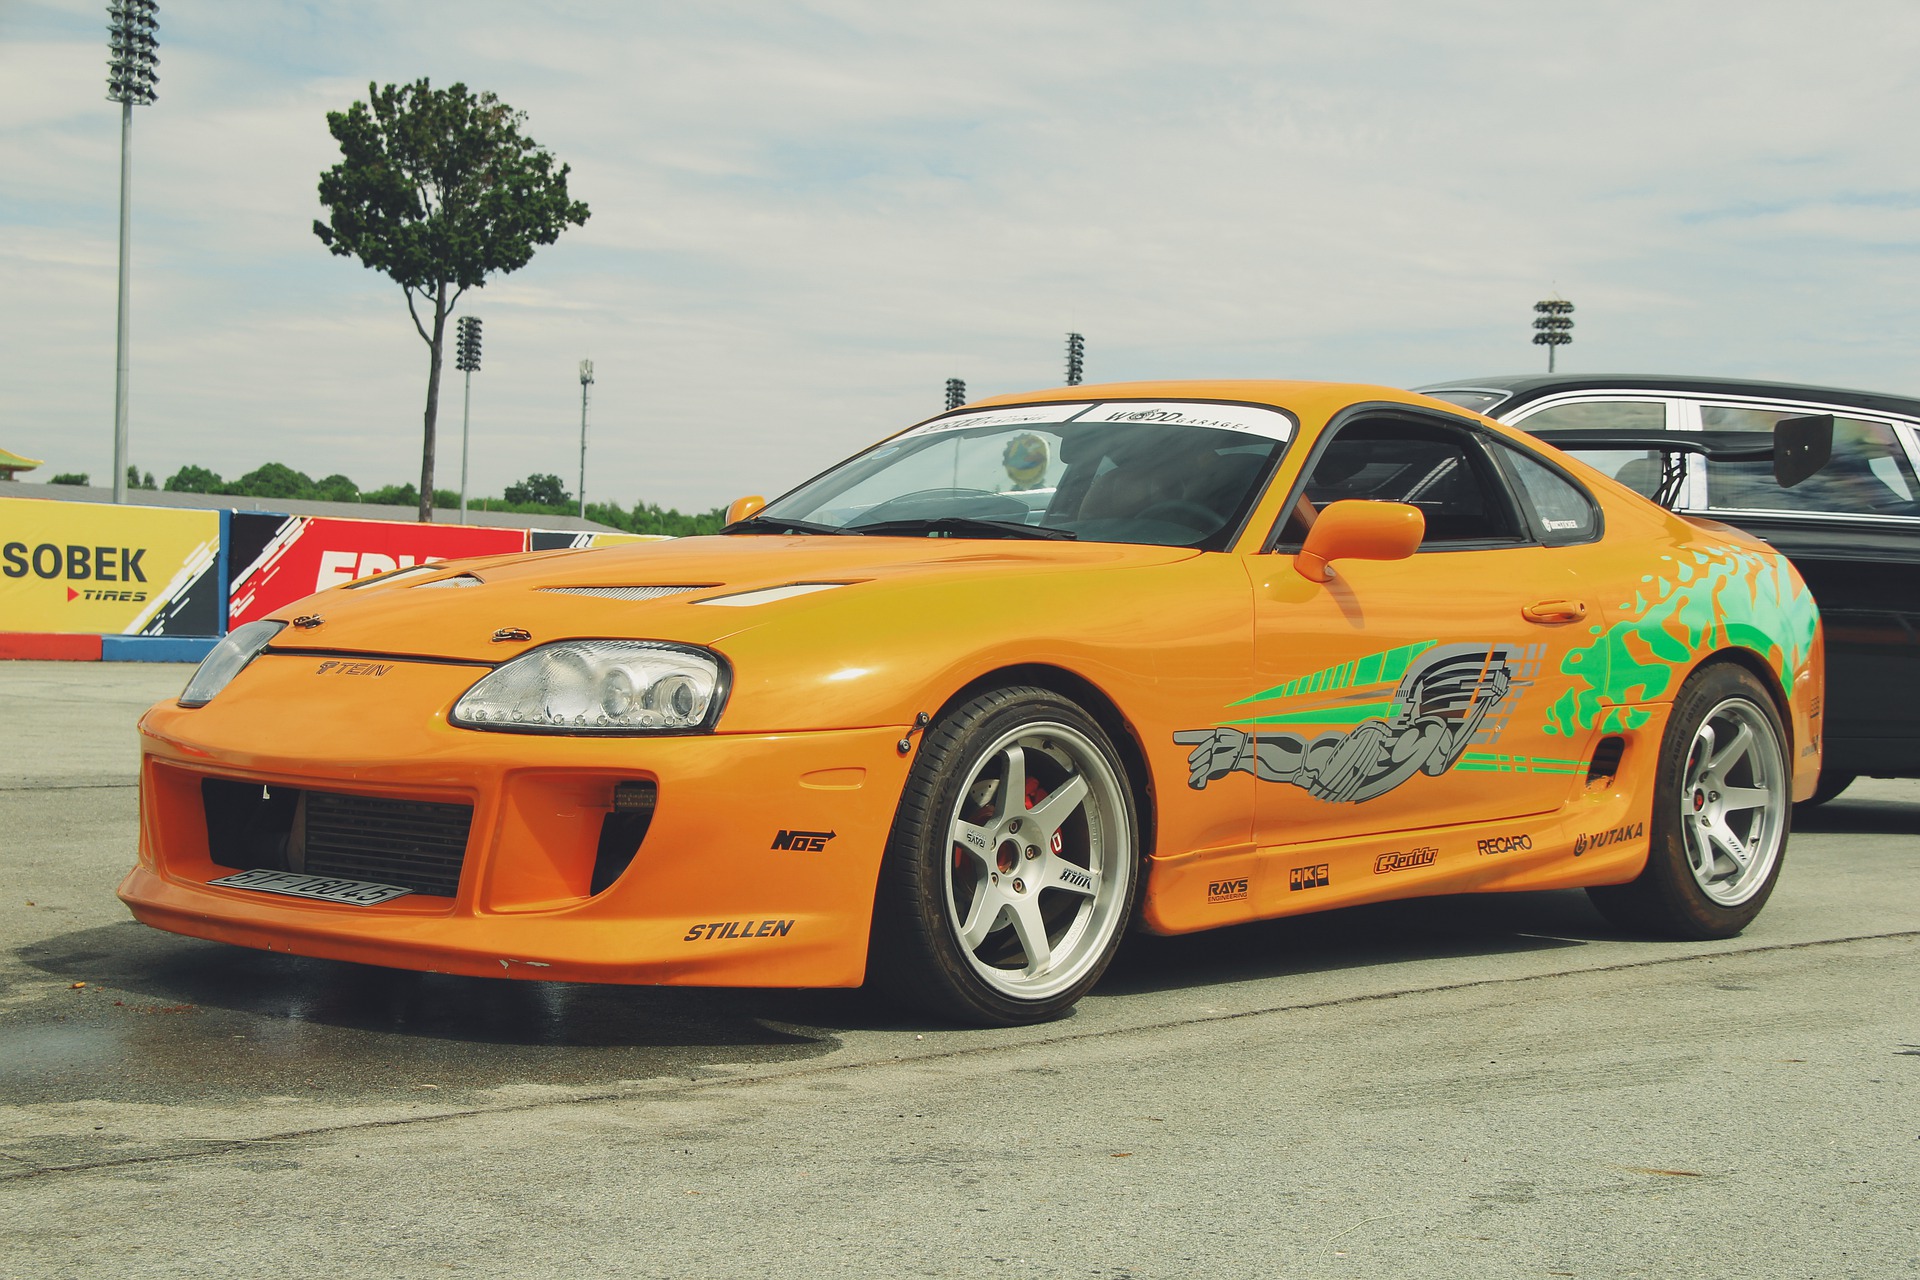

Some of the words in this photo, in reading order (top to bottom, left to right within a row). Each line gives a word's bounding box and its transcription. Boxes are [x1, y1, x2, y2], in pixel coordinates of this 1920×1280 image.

[2, 541, 148, 583] SOBEK
[336, 662, 394, 677] TEIN
[770, 829, 834, 852] NOS
[1477, 834, 1533, 856] RECARO
[1589, 821, 1643, 850] YUTAKA
[1375, 847, 1438, 874] GReddy
[223, 870, 402, 901] 51F-160.45
[1208, 879, 1248, 896] RAYS
[1290, 864, 1329, 890] HKS
[1208, 892, 1248, 903] ENGINEERING
[684, 919, 796, 942] STILLEN
